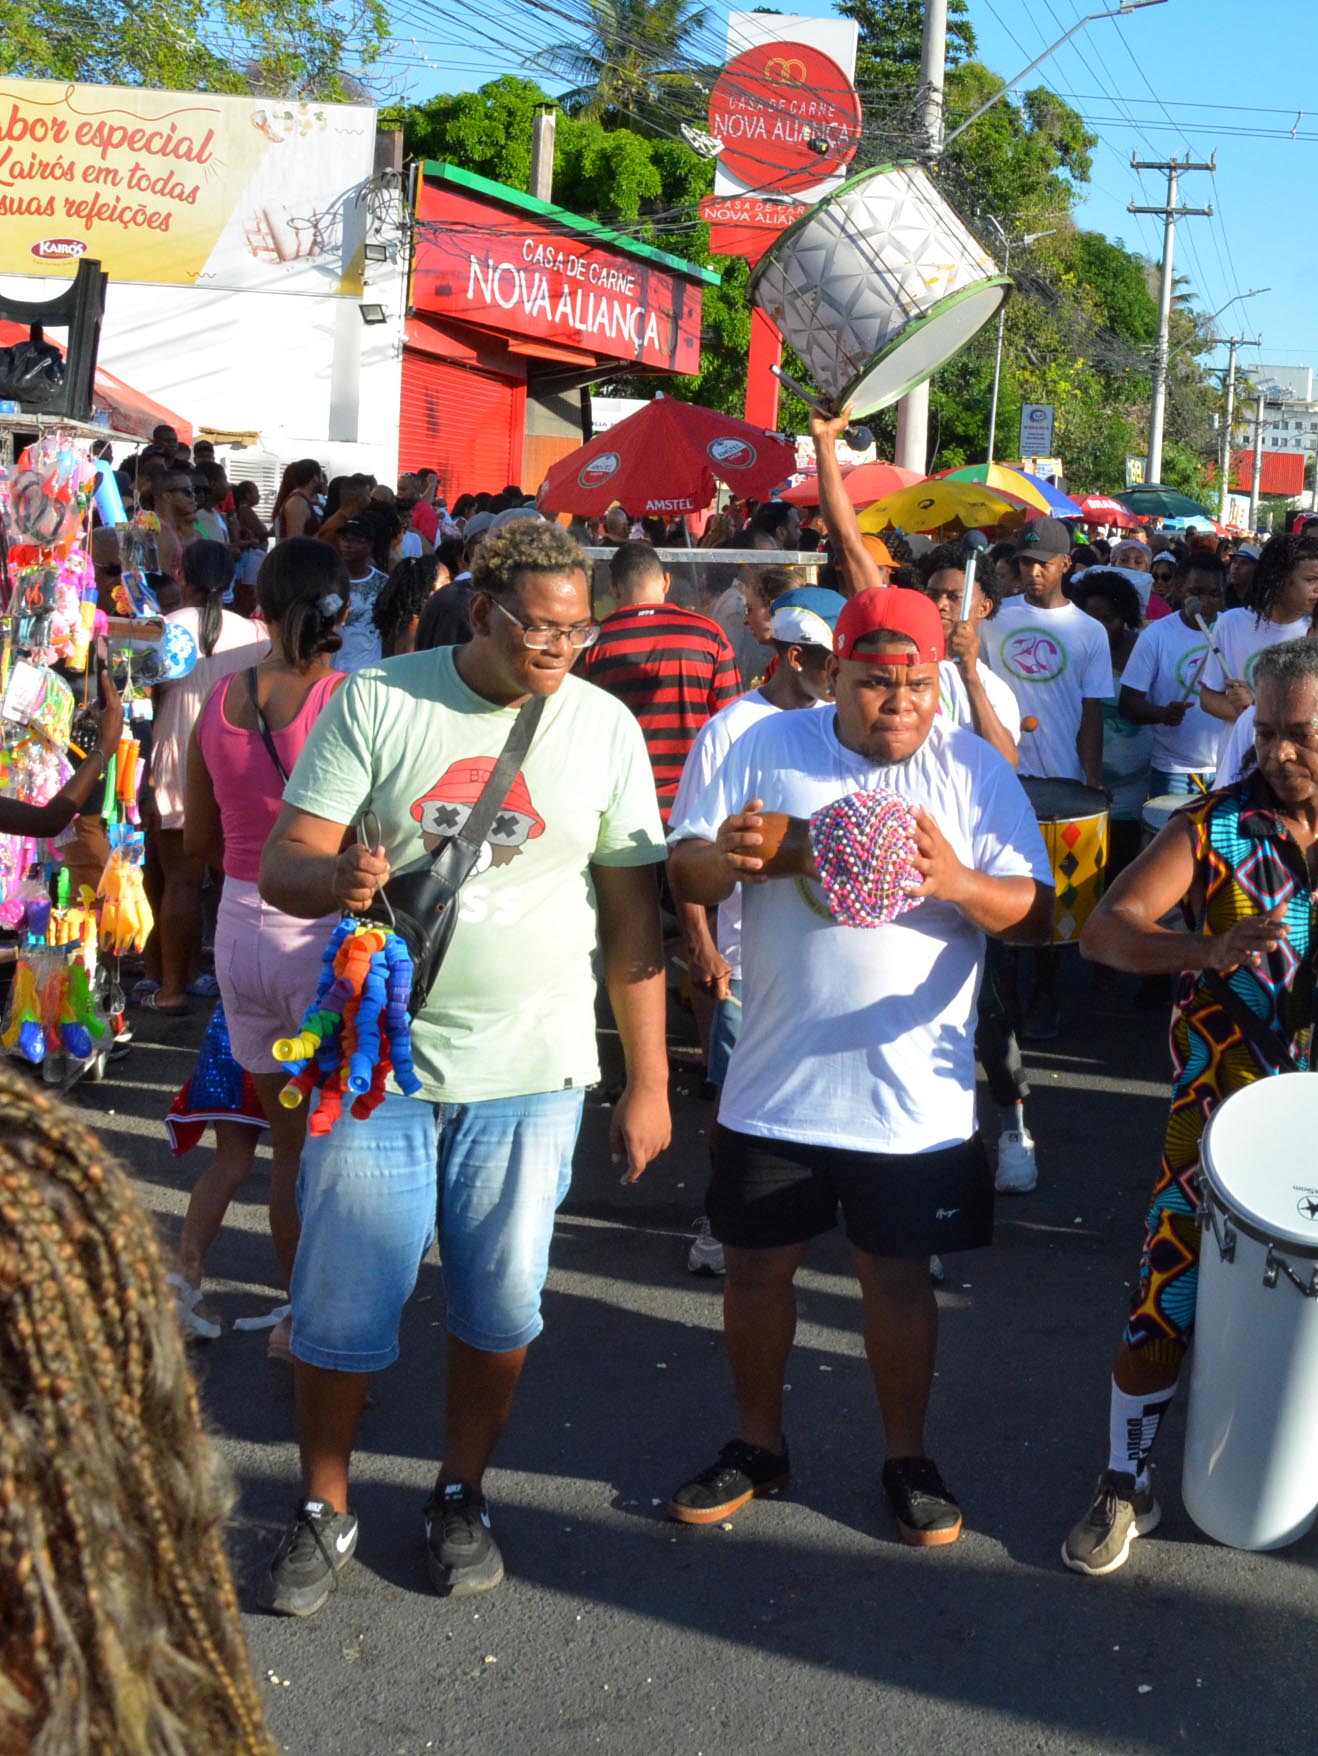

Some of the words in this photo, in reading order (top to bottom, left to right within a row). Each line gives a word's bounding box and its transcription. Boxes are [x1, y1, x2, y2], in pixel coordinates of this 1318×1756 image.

[729, 97, 764, 112] CASA
[769, 99, 786, 113] DE
[790, 101, 836, 117] CARNE
[0, 104, 69, 144] bor
[75, 120, 215, 164] especial
[714, 113, 767, 139] NOVA
[82, 164, 123, 187] em
[127, 162, 200, 205] todas
[64, 191, 173, 232] refeições
[704, 208, 751, 221] NOVA
[755, 212, 800, 225] ALIAN
[778, 203, 806, 214] CAR
[523, 239, 563, 272] CASA
[567, 255, 586, 281] DE
[589, 263, 635, 296] CARNE
[467, 255, 552, 321] NOVA
[555, 284, 660, 355] ALIANÇA
[645, 499, 693, 511] AMSTEL
